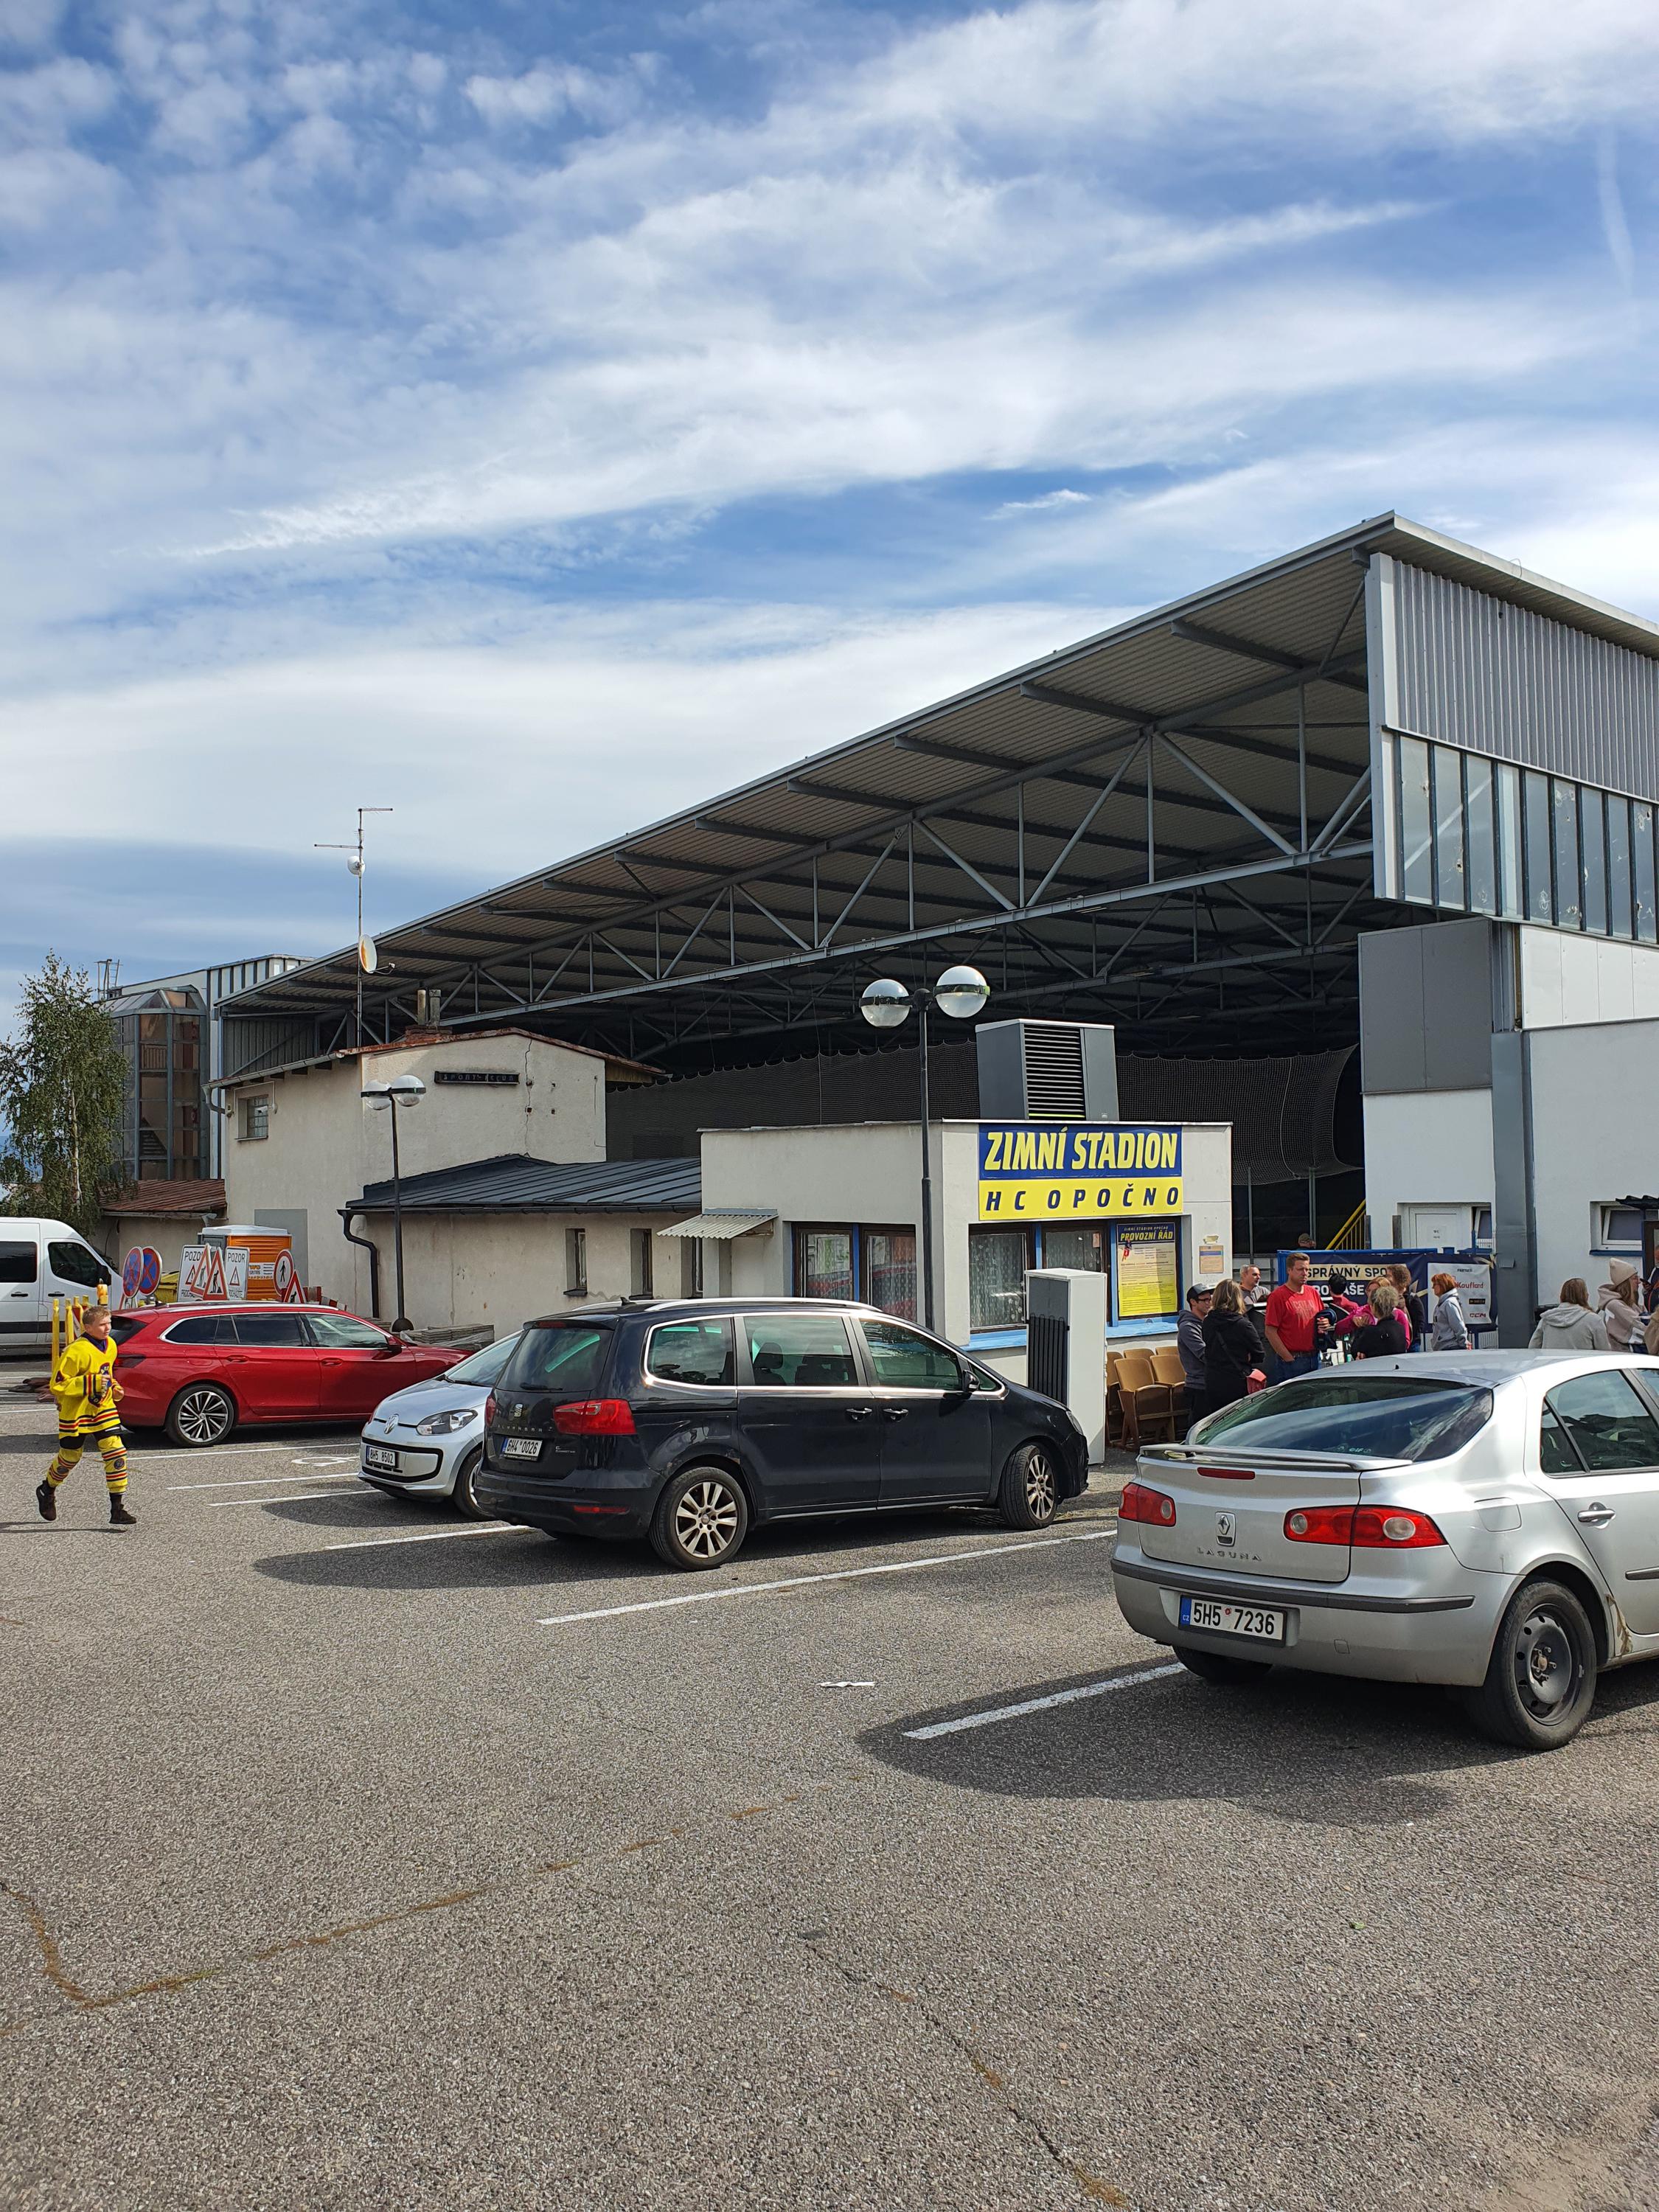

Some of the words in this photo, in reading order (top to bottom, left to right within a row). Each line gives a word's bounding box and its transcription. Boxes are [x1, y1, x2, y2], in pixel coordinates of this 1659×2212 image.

[984, 1126, 1068, 1170] ZIMNÍ
[1071, 1131, 1178, 1169] STADION
[985, 1191, 1026, 1211] HC
[1047, 1183, 1179, 1209] OPOČNO
[1120, 1230, 1157, 1242] PROVOZNÍ
[1158, 1229, 1173, 1240] ŘÁD
[184, 1251, 204, 1262] POZO
[228, 1253, 246, 1263] POZOR
[1307, 1265, 1360, 1278] SPRÁVNÝ
[1365, 1267, 1388, 1278] SPO
[1343, 1283, 1365, 1295] AŠE
[507, 1439, 519, 1453] 6H4
[521, 1441, 538, 1455] 0026
[1197, 1547, 1262, 1562] LAGUNA
[1193, 1602, 1222, 1627] 5H5
[1234, 1608, 1275, 1635] 7236
